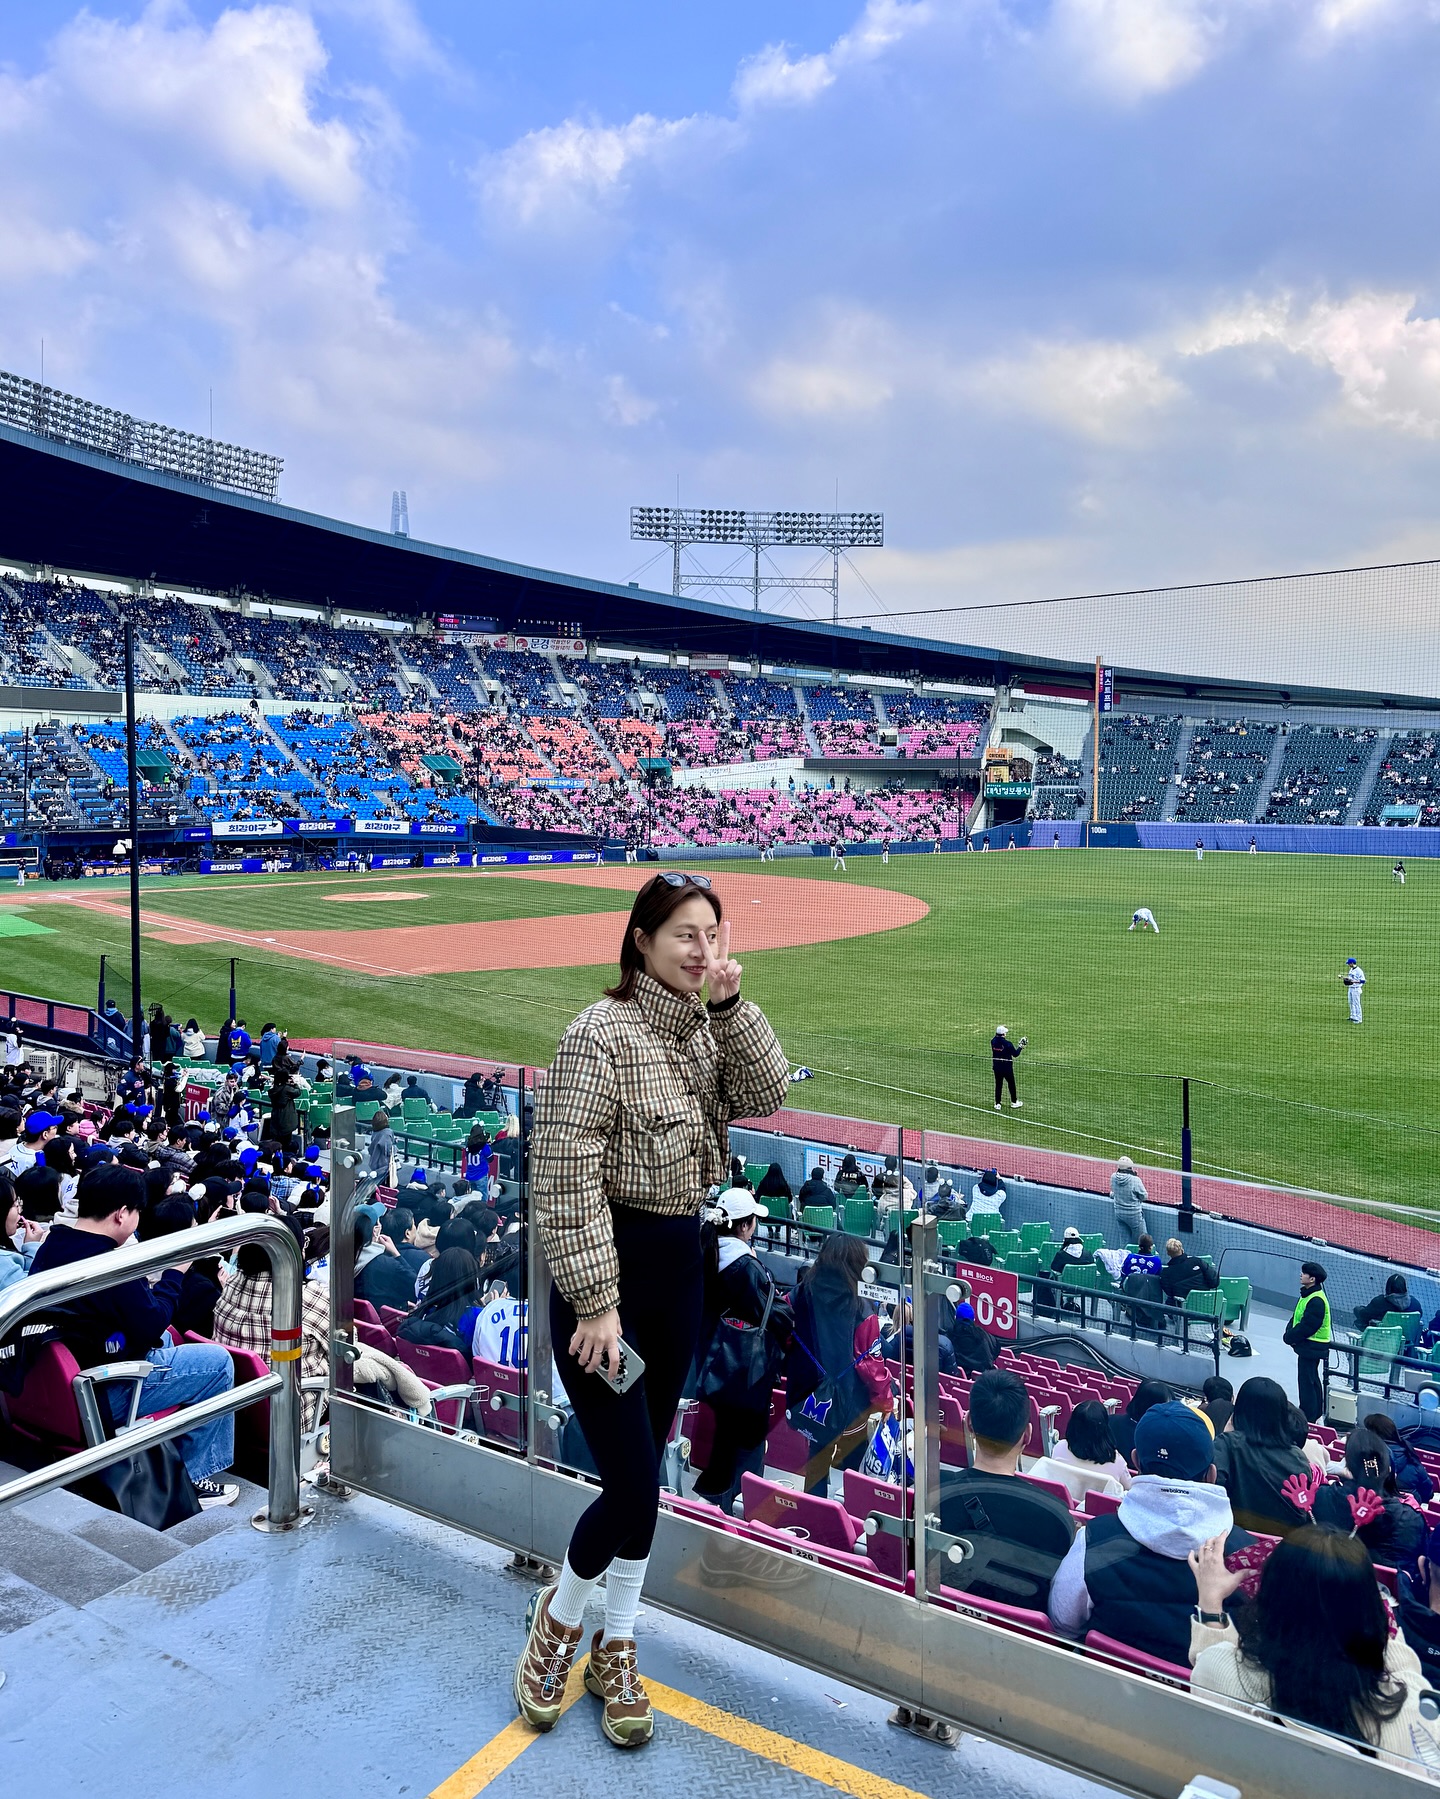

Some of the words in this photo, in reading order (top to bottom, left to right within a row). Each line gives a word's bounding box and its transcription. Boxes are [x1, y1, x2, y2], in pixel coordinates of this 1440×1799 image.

[531, 639, 549, 649] 문경
[298, 822, 336, 830] 최강야구
[420, 825, 457, 833] 최강야구
[210, 863, 243, 871] 최강야구
[468, 1153, 480, 1166] 10
[976, 1272, 994, 1282] Block
[498, 1326, 528, 1369] 10
[799, 1392, 833, 1427] M
[878, 1491, 892, 1499] 193
[1298, 1491, 1307, 1503] G
[779, 1498, 794, 1508] 194
[1357, 1506, 1368, 1518] G
[795, 1550, 814, 1561] 220
